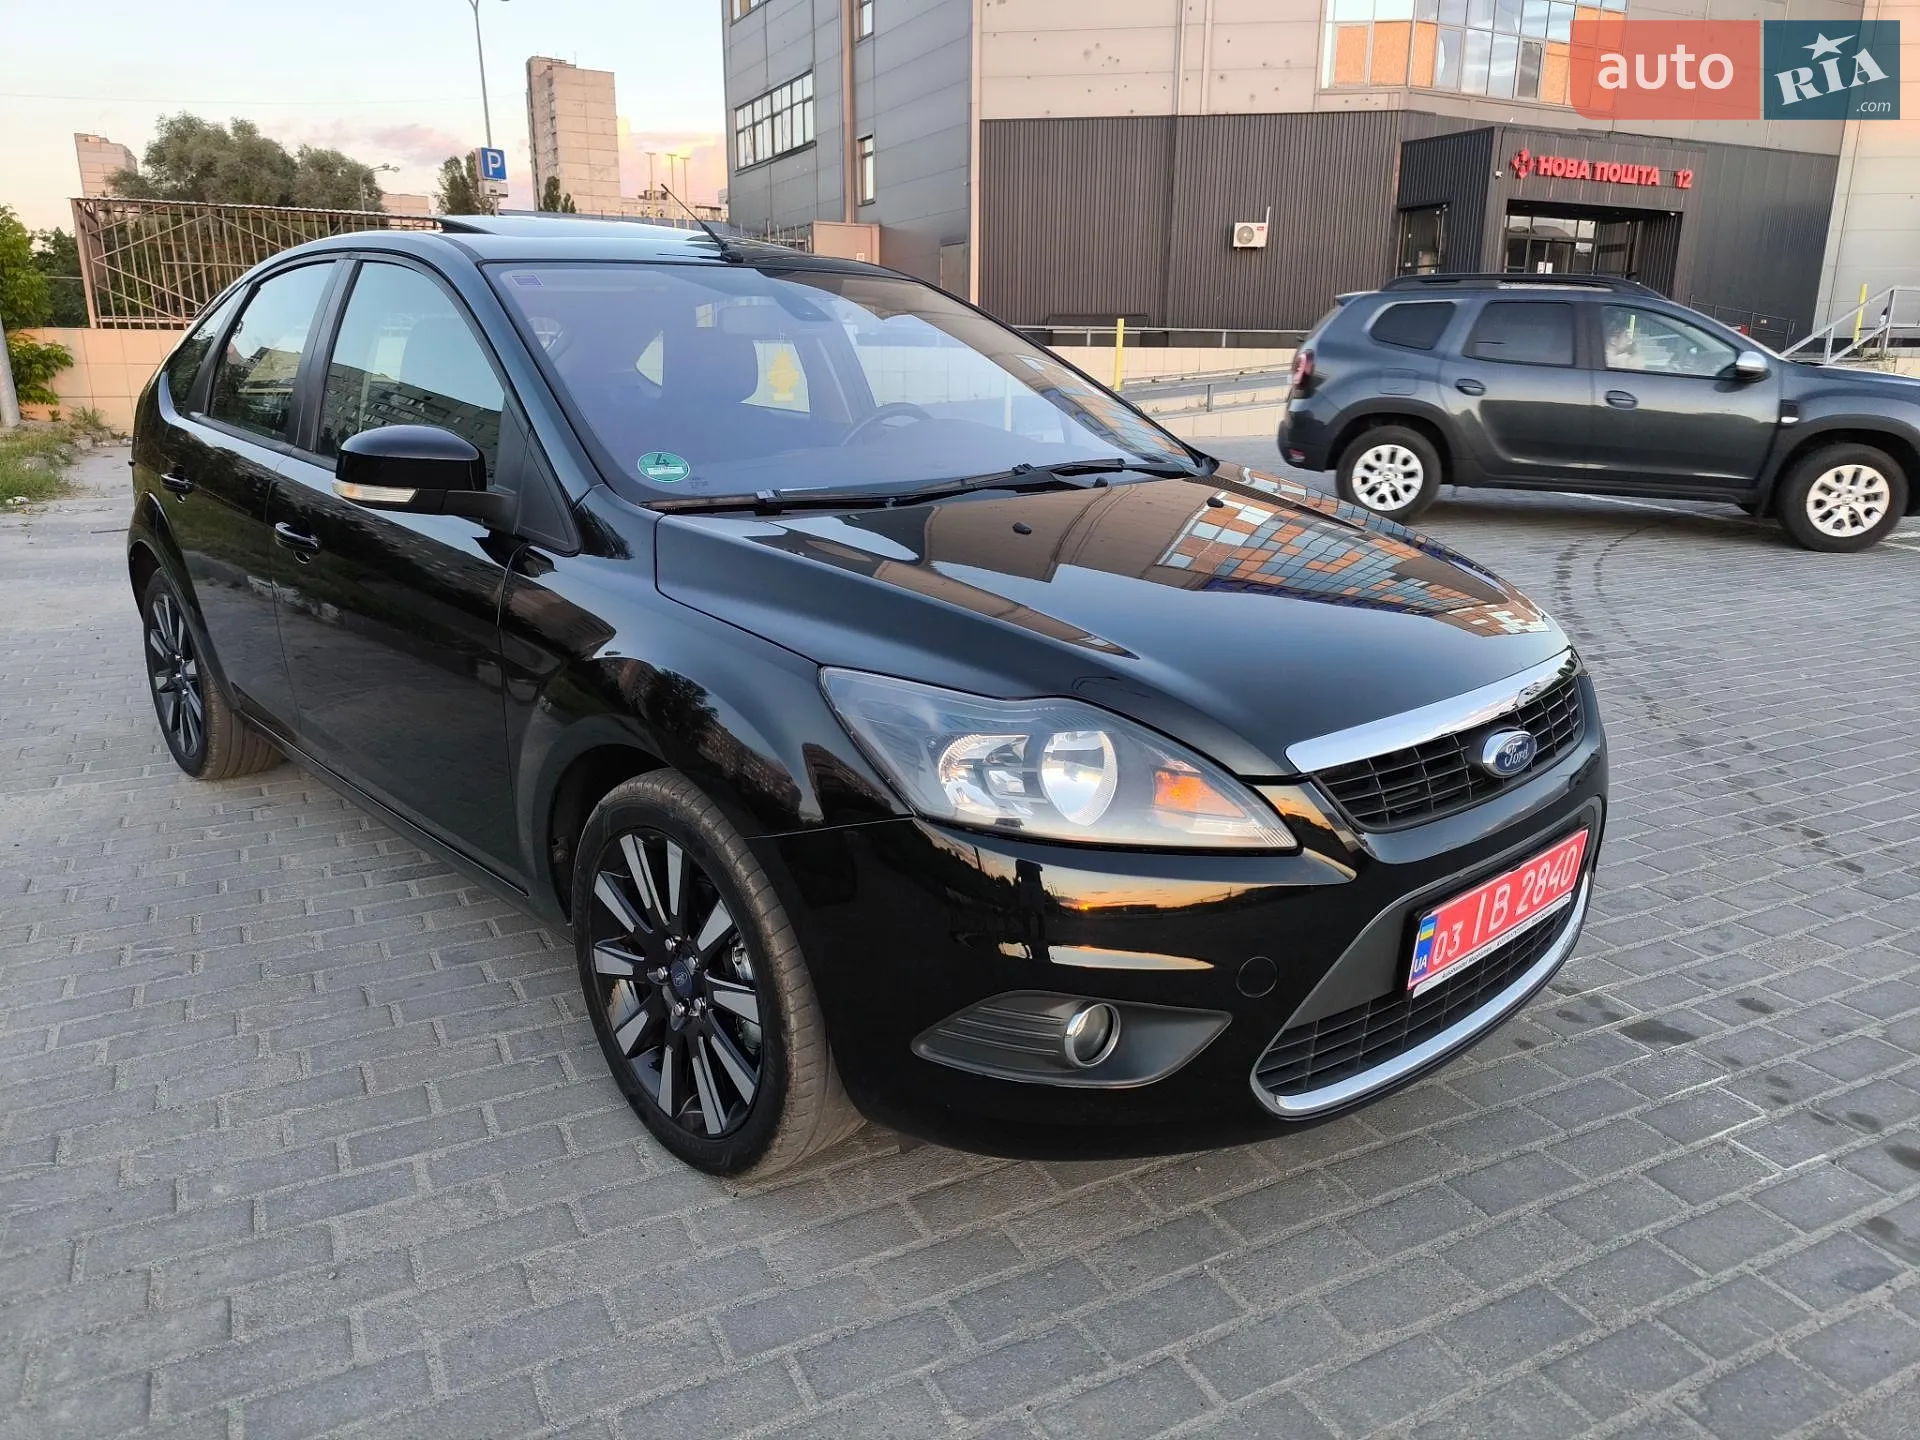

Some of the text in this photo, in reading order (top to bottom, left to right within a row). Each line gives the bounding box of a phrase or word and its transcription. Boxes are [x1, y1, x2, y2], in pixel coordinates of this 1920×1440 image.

[487, 151, 502, 176] P
[1538, 155, 1694, 189] НОВА ПОШТА 12
[1504, 740, 1530, 767] Ford
[1432, 920, 1464, 964] 03
[1515, 844, 1579, 917] 2840
[1414, 954, 1428, 973] UA
